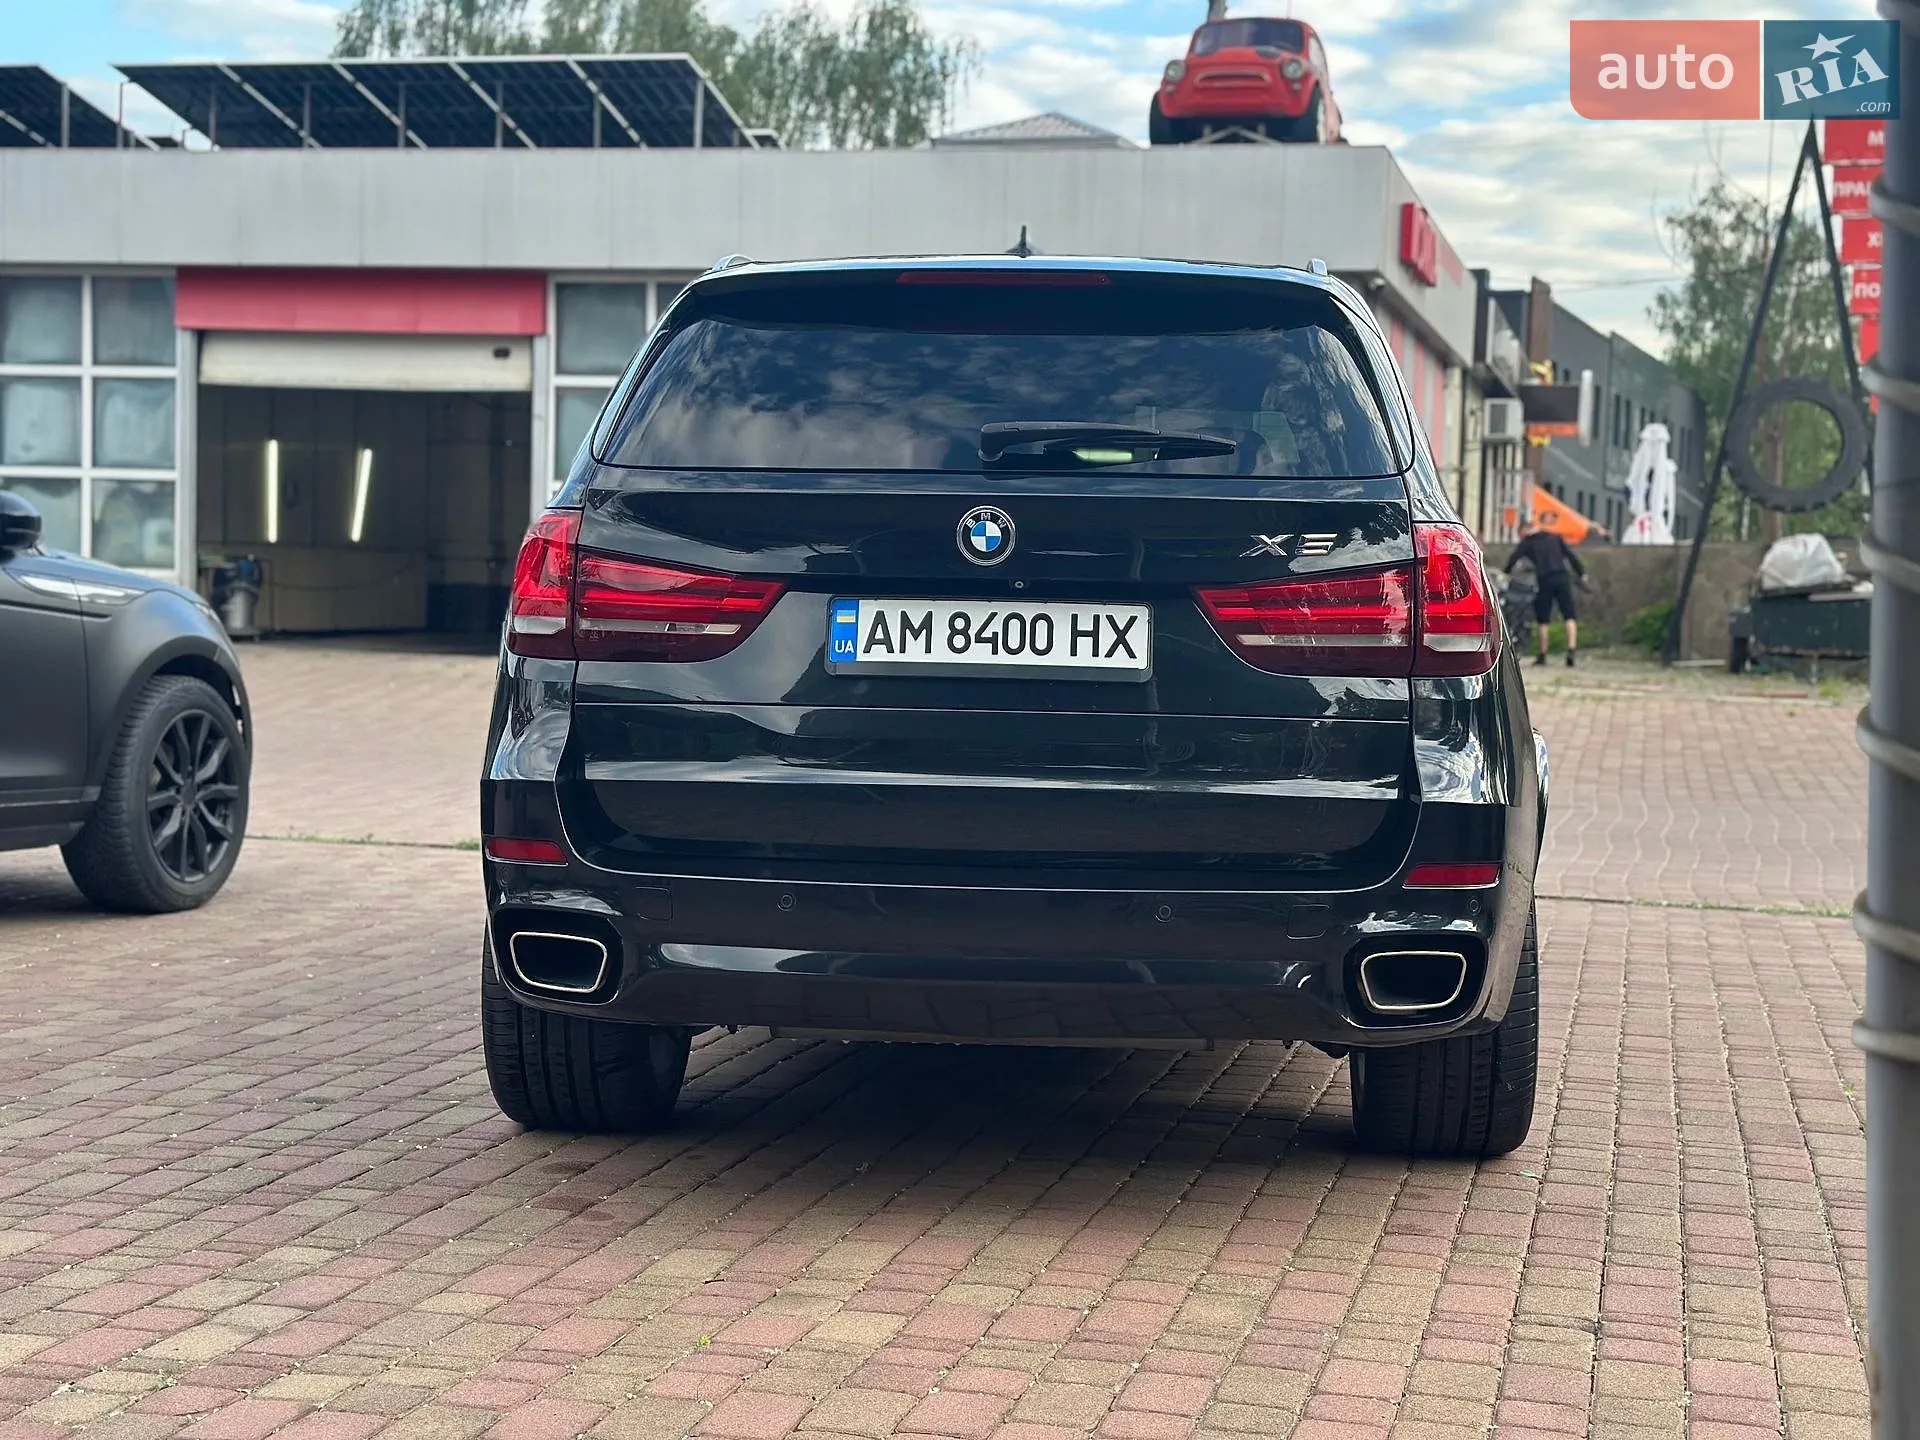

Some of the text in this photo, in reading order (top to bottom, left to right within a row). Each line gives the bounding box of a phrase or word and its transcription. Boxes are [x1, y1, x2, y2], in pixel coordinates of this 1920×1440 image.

[965, 512, 1007, 529] BMW
[1239, 533, 1338, 557] X5
[863, 610, 1139, 659] AM 8400 HX
[834, 639, 855, 655] UA
